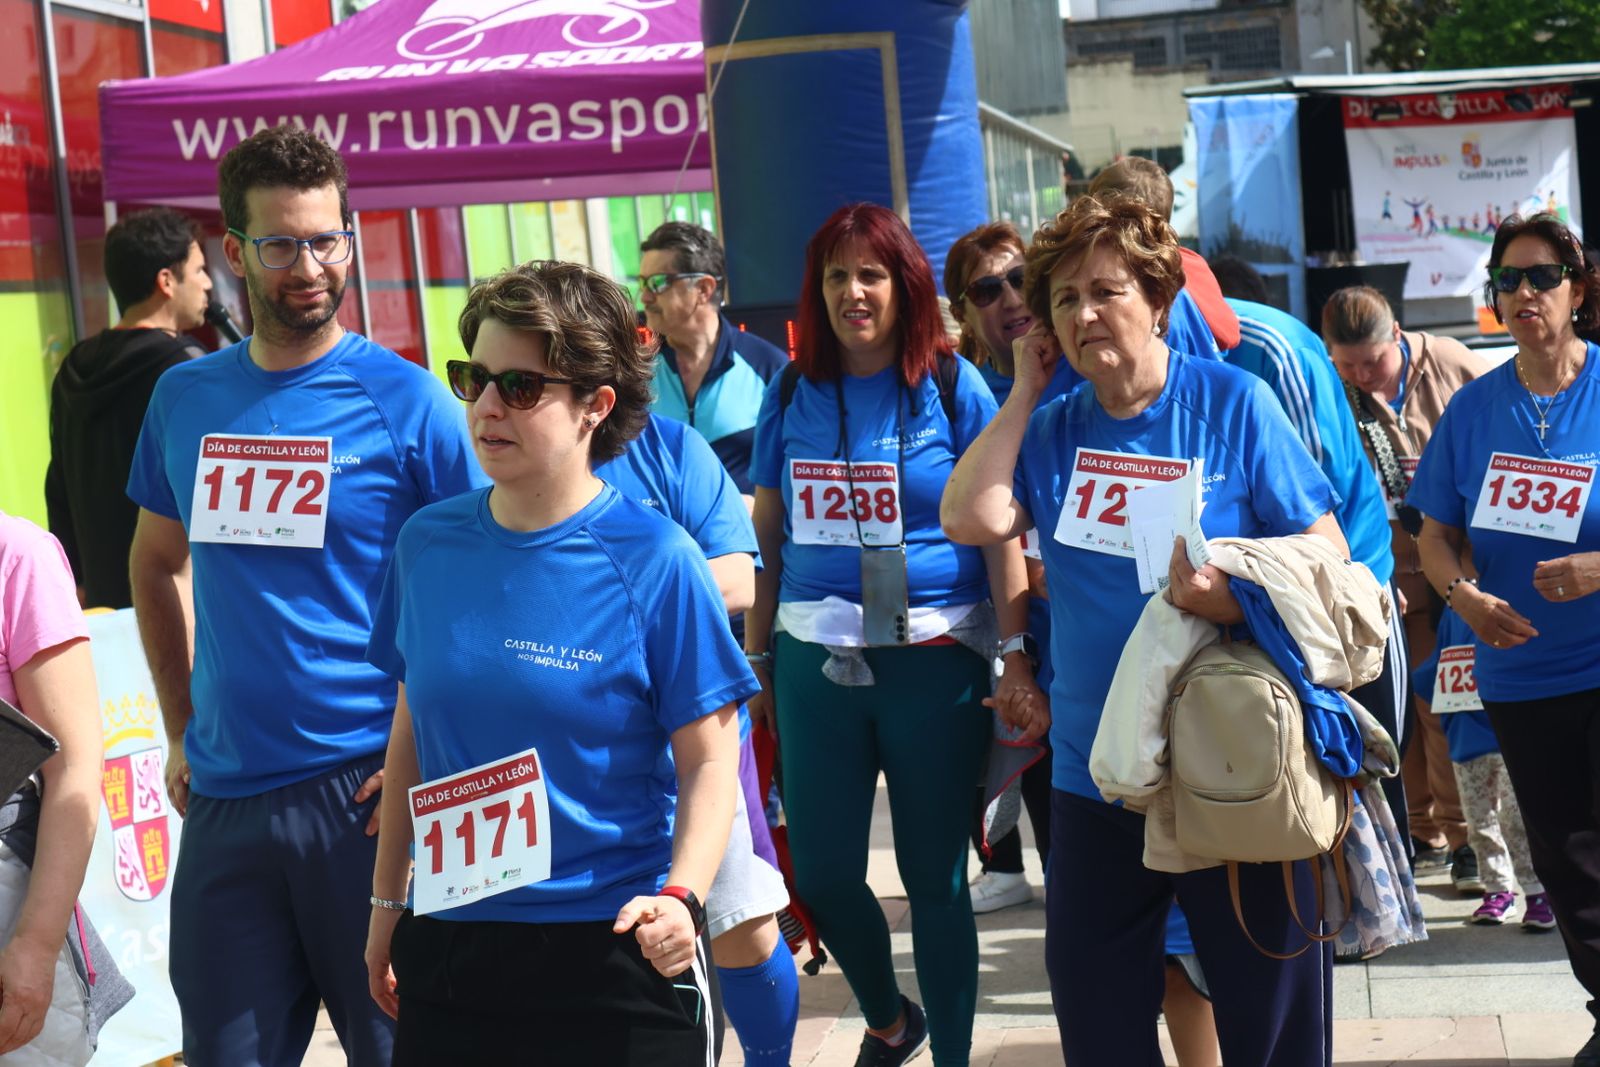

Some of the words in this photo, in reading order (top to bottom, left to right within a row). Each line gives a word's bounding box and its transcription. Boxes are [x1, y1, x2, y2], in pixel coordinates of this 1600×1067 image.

[1486, 156, 1513, 167] Junta
[1515, 155, 1528, 164] de
[1458, 169, 1495, 180] Castilla
[1504, 167, 1529, 178] León
[207, 441, 225, 453] DÍA
[227, 444, 241, 454] DE
[243, 445, 288, 456] CASTILLA
[290, 446, 297, 455] Y
[298, 445, 325, 456] LEÓN
[333, 454, 361, 465] LEÓN
[1081, 456, 1097, 467] DÍA
[1099, 459, 1111, 469] DE
[1113, 461, 1150, 474] CASTILLA
[1151, 465, 1158, 475] Y
[1158, 464, 1183, 477] LEÓN
[1494, 458, 1509, 467] DÍA
[1510, 460, 1521, 469] DE
[1522, 463, 1558, 474] CASTILLA
[1566, 467, 1589, 478] LEÓN
[796, 465, 812, 475] DÍA
[813, 467, 825, 475] DE
[872, 468, 894, 478] LEÓN
[203, 465, 325, 515] 1172
[1489, 475, 1582, 518] 1334
[798, 485, 898, 523] 1238
[1075, 479, 1145, 526] 12
[504, 639, 555, 655] CASTILLA
[560, 645, 568, 658] Y
[571, 649, 603, 663] LEÓN
[517, 653, 534, 661] NOS
[534, 655, 579, 671] IMPULSA
[416, 793, 435, 808] DÍA
[436, 789, 451, 803] DE
[452, 776, 495, 797] CASTILLA
[497, 773, 504, 784] Y
[506, 763, 534, 781] LEÓN
[423, 791, 538, 875] 1171
